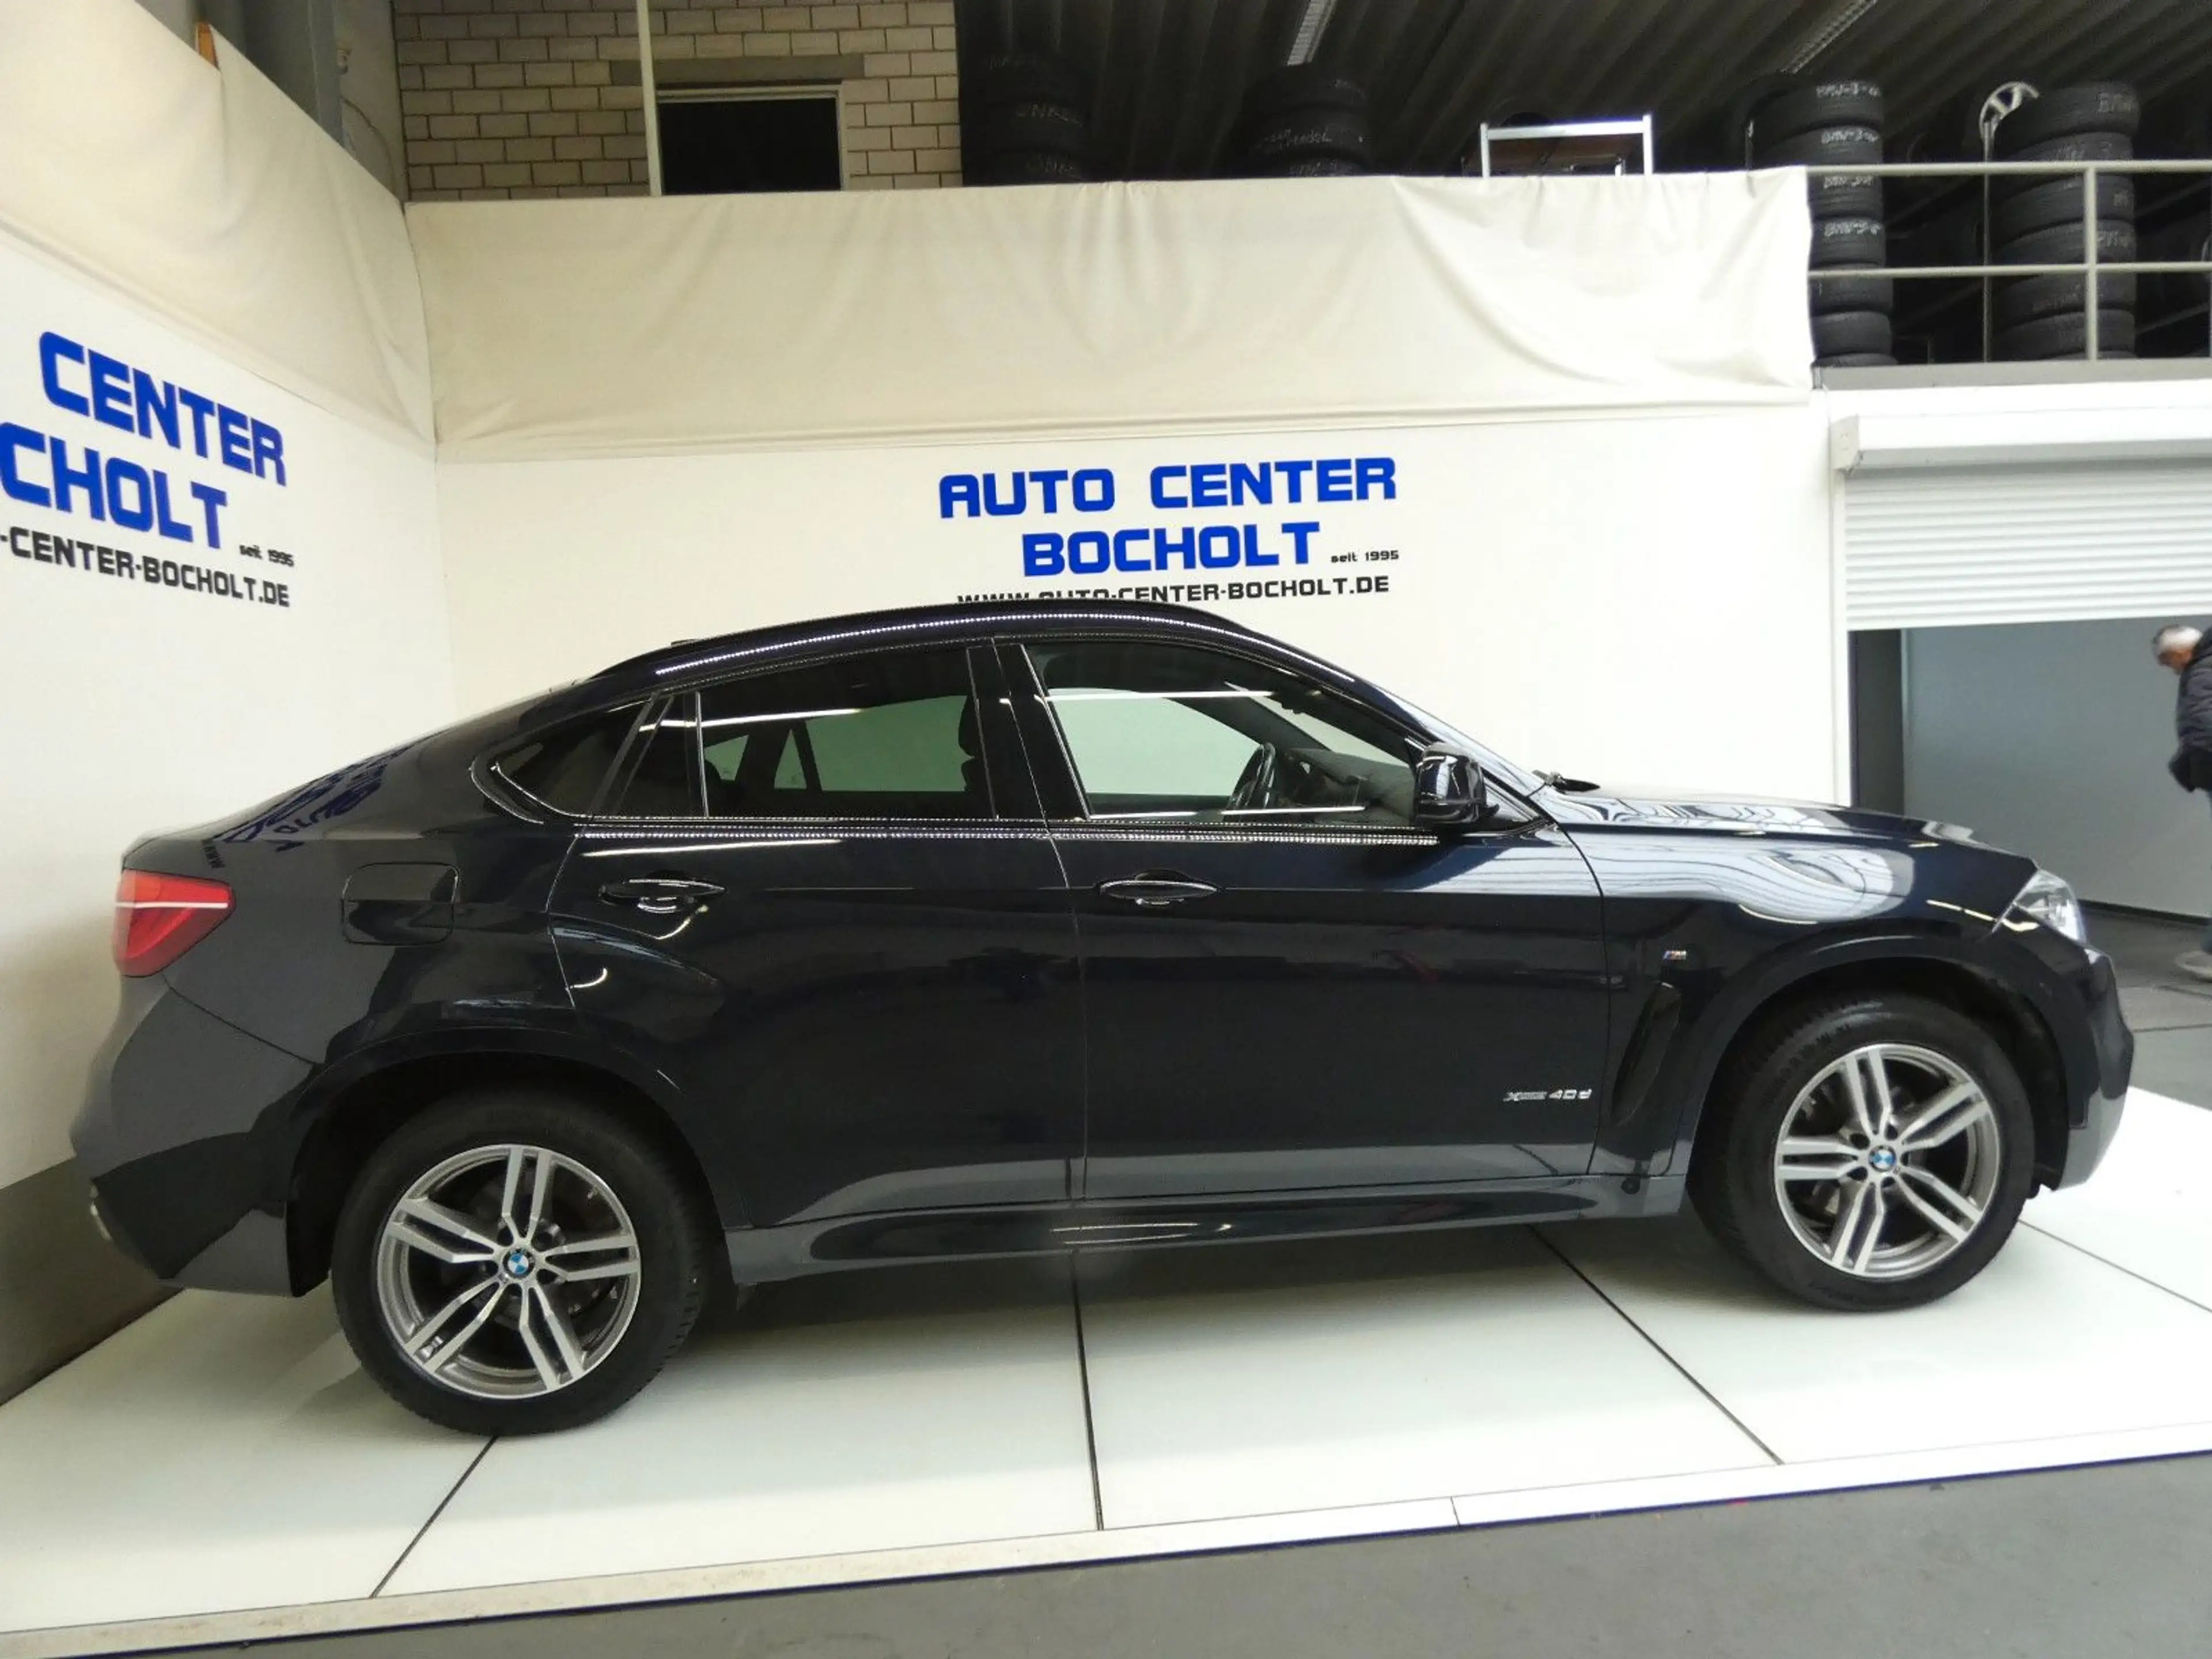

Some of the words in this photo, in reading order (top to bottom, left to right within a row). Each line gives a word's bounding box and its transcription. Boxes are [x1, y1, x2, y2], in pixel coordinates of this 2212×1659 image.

[40, 332, 287, 486] CENTER
[939, 468, 1115, 518] AUTO
[1150, 457, 1396, 509] CENTER
[267, 549, 294, 567] 1995
[1022, 521, 1320, 577] BOCHOLT
[1331, 551, 1358, 563] seit
[1365, 550, 1399, 561] 1995
[957, 575, 1389, 603] TO-CENTER-BOCHOLT.DE
